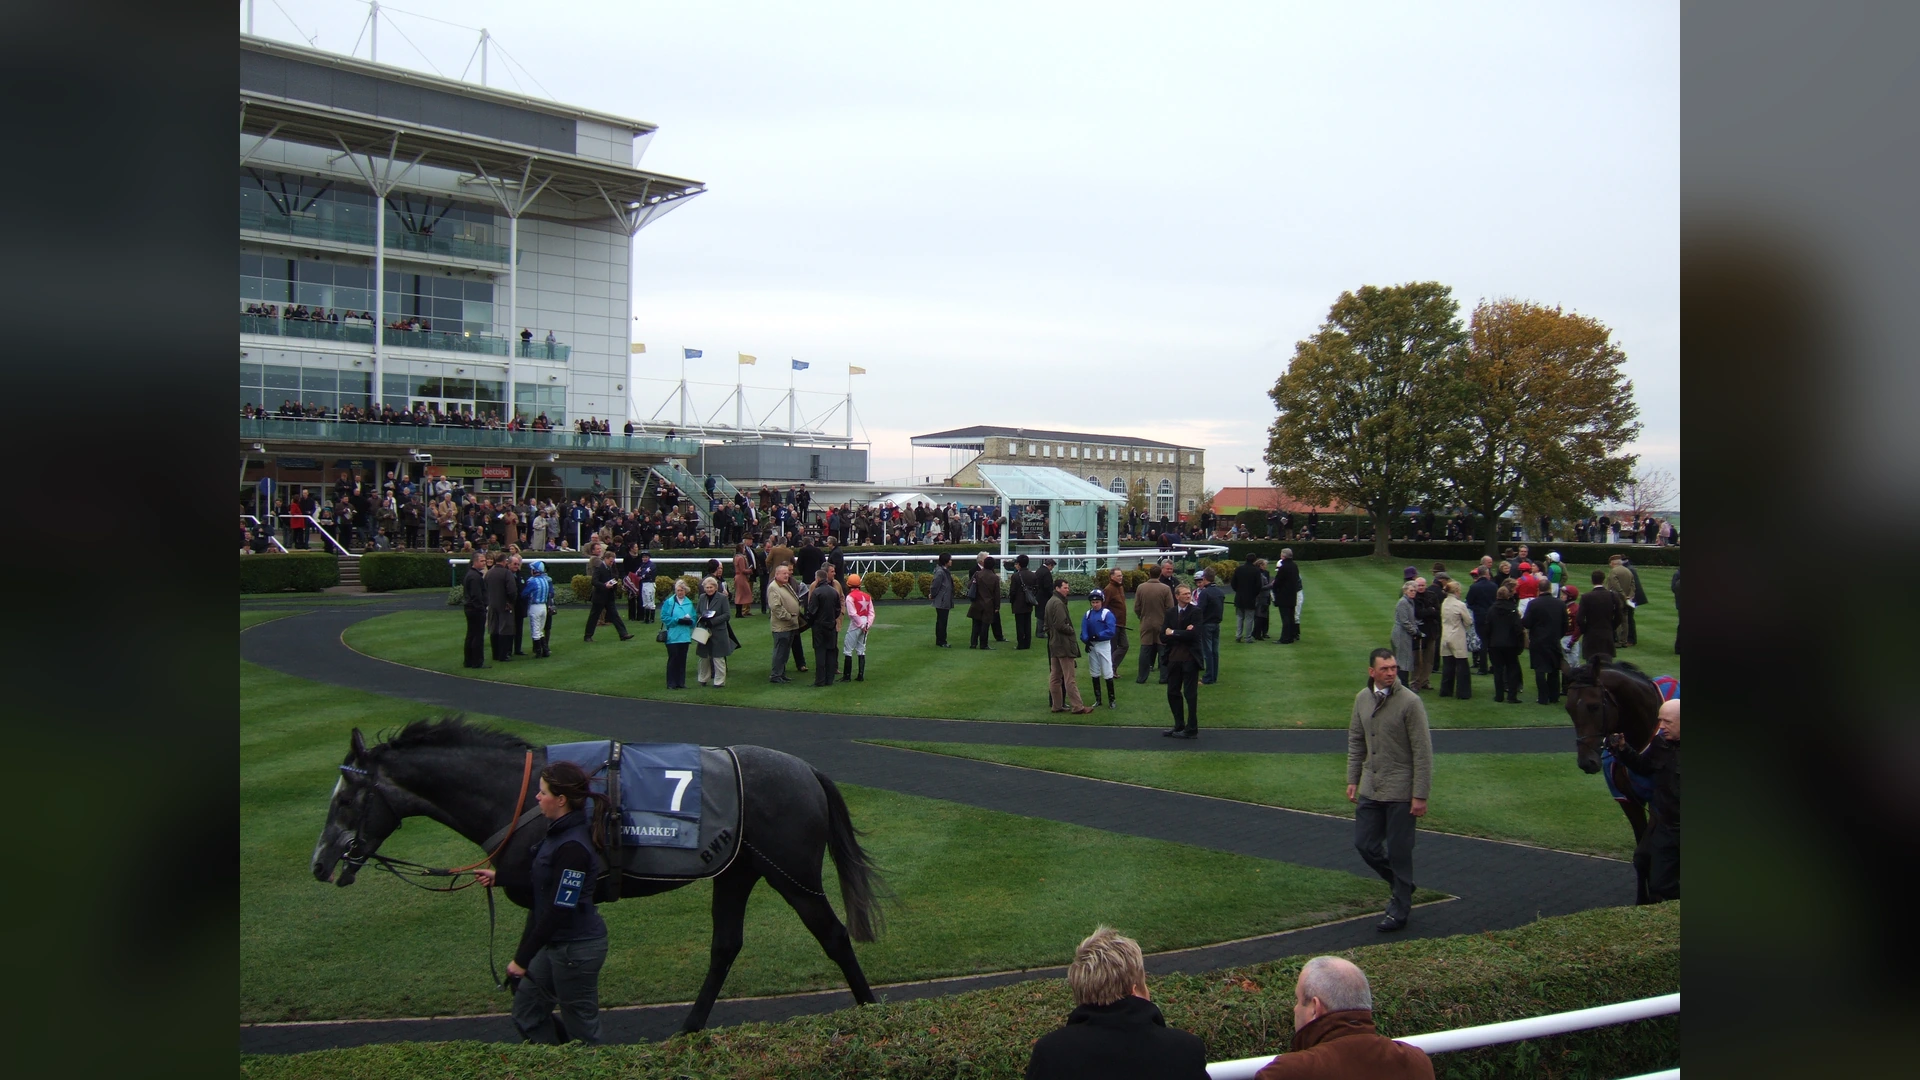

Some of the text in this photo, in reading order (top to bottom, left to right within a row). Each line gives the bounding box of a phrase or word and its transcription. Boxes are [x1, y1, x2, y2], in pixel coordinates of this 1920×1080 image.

[484, 468, 509, 477] betting
[665, 770, 693, 812] 7
[619, 826, 678, 837] WMARKET
[700, 829, 732, 864] BWH
[566, 871, 582, 879] 3RD
[562, 878, 582, 887] RACE
[564, 890, 573, 902] 7
